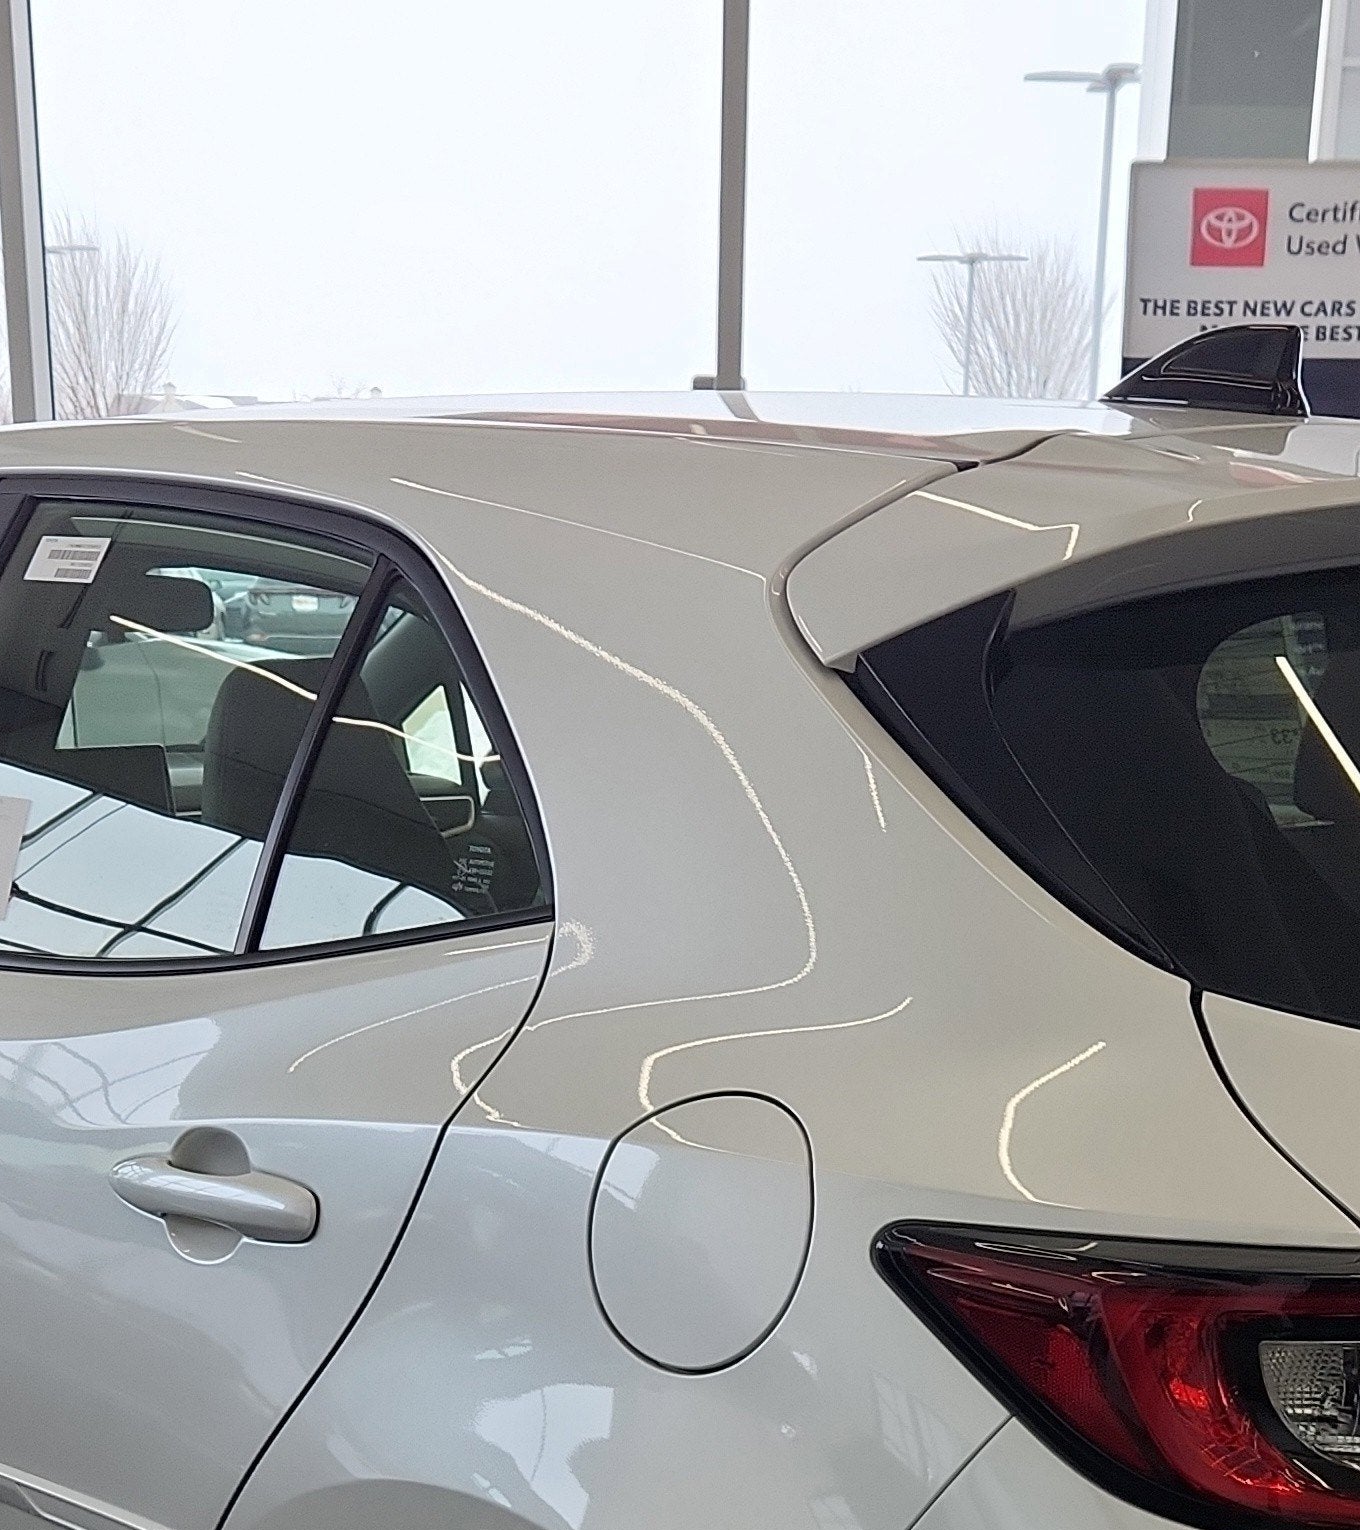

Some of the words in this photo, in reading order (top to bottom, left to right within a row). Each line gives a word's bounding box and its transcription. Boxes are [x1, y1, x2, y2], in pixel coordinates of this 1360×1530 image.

[1286, 234, 1348, 256] Used
[1140, 298, 1181, 317] THE
[1186, 299, 1238, 318] BEST
[1242, 300, 1296, 318] NEW
[1299, 300, 1357, 318] CARS
